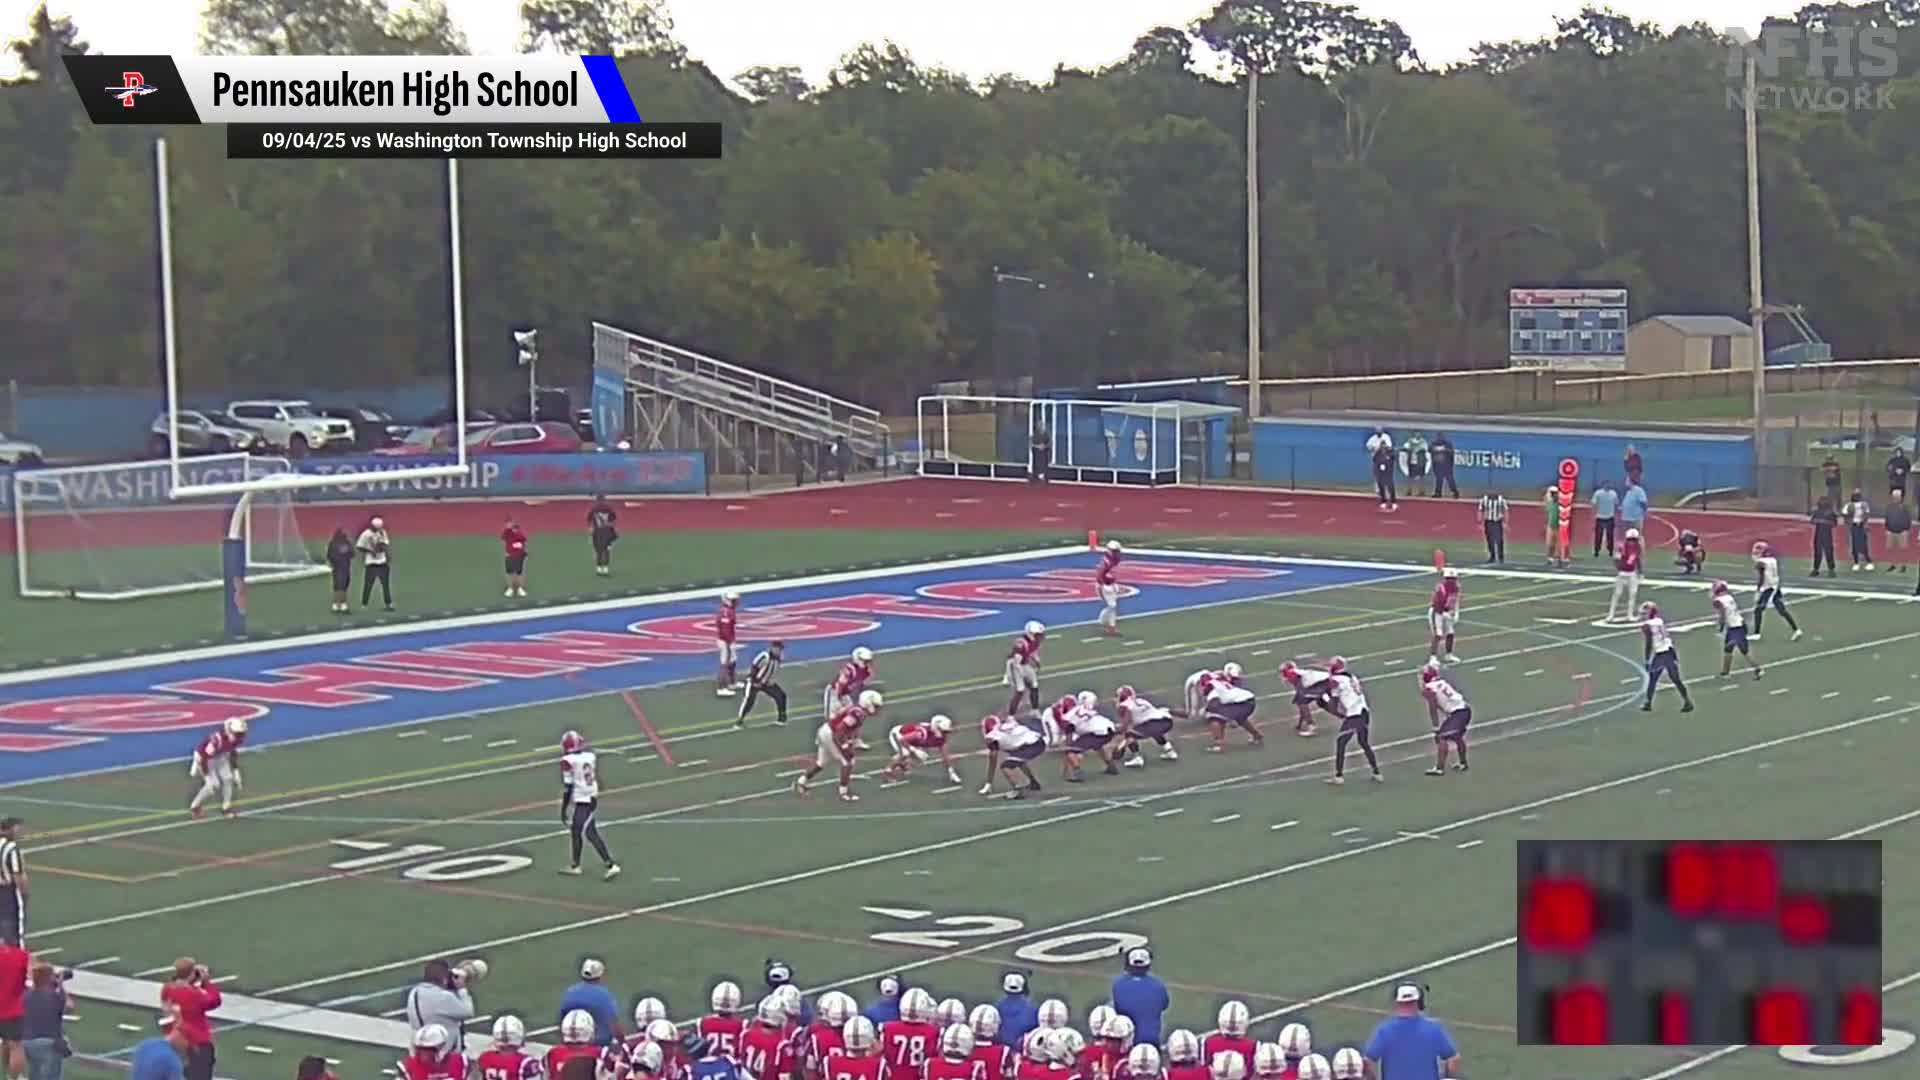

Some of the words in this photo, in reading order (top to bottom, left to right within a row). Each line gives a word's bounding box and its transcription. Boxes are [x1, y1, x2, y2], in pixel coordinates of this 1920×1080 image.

[0, 560, 1295, 753] SHINGTON
[328, 842, 534, 881] 10
[867, 913, 1149, 963] 20
[894, 1035, 926, 1067] 78
